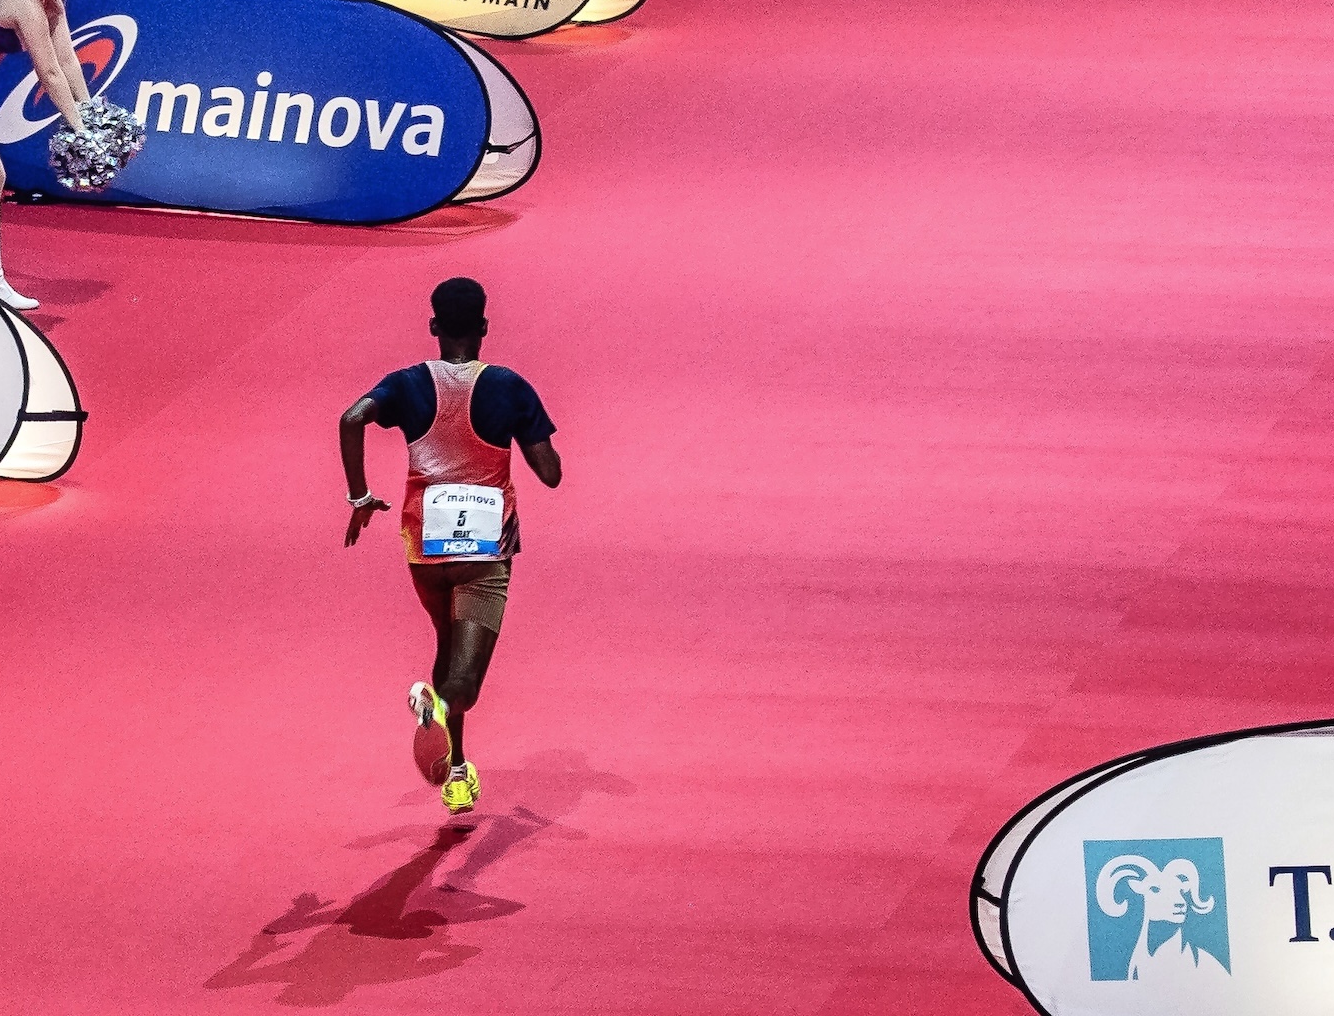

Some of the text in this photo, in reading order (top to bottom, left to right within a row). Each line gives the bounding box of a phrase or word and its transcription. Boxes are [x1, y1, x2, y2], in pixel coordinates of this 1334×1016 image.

[133, 71, 446, 157] mainova
[447, 493, 496, 505] mainova
[457, 510, 467, 527] 5
[443, 541, 479, 553] HOKA
